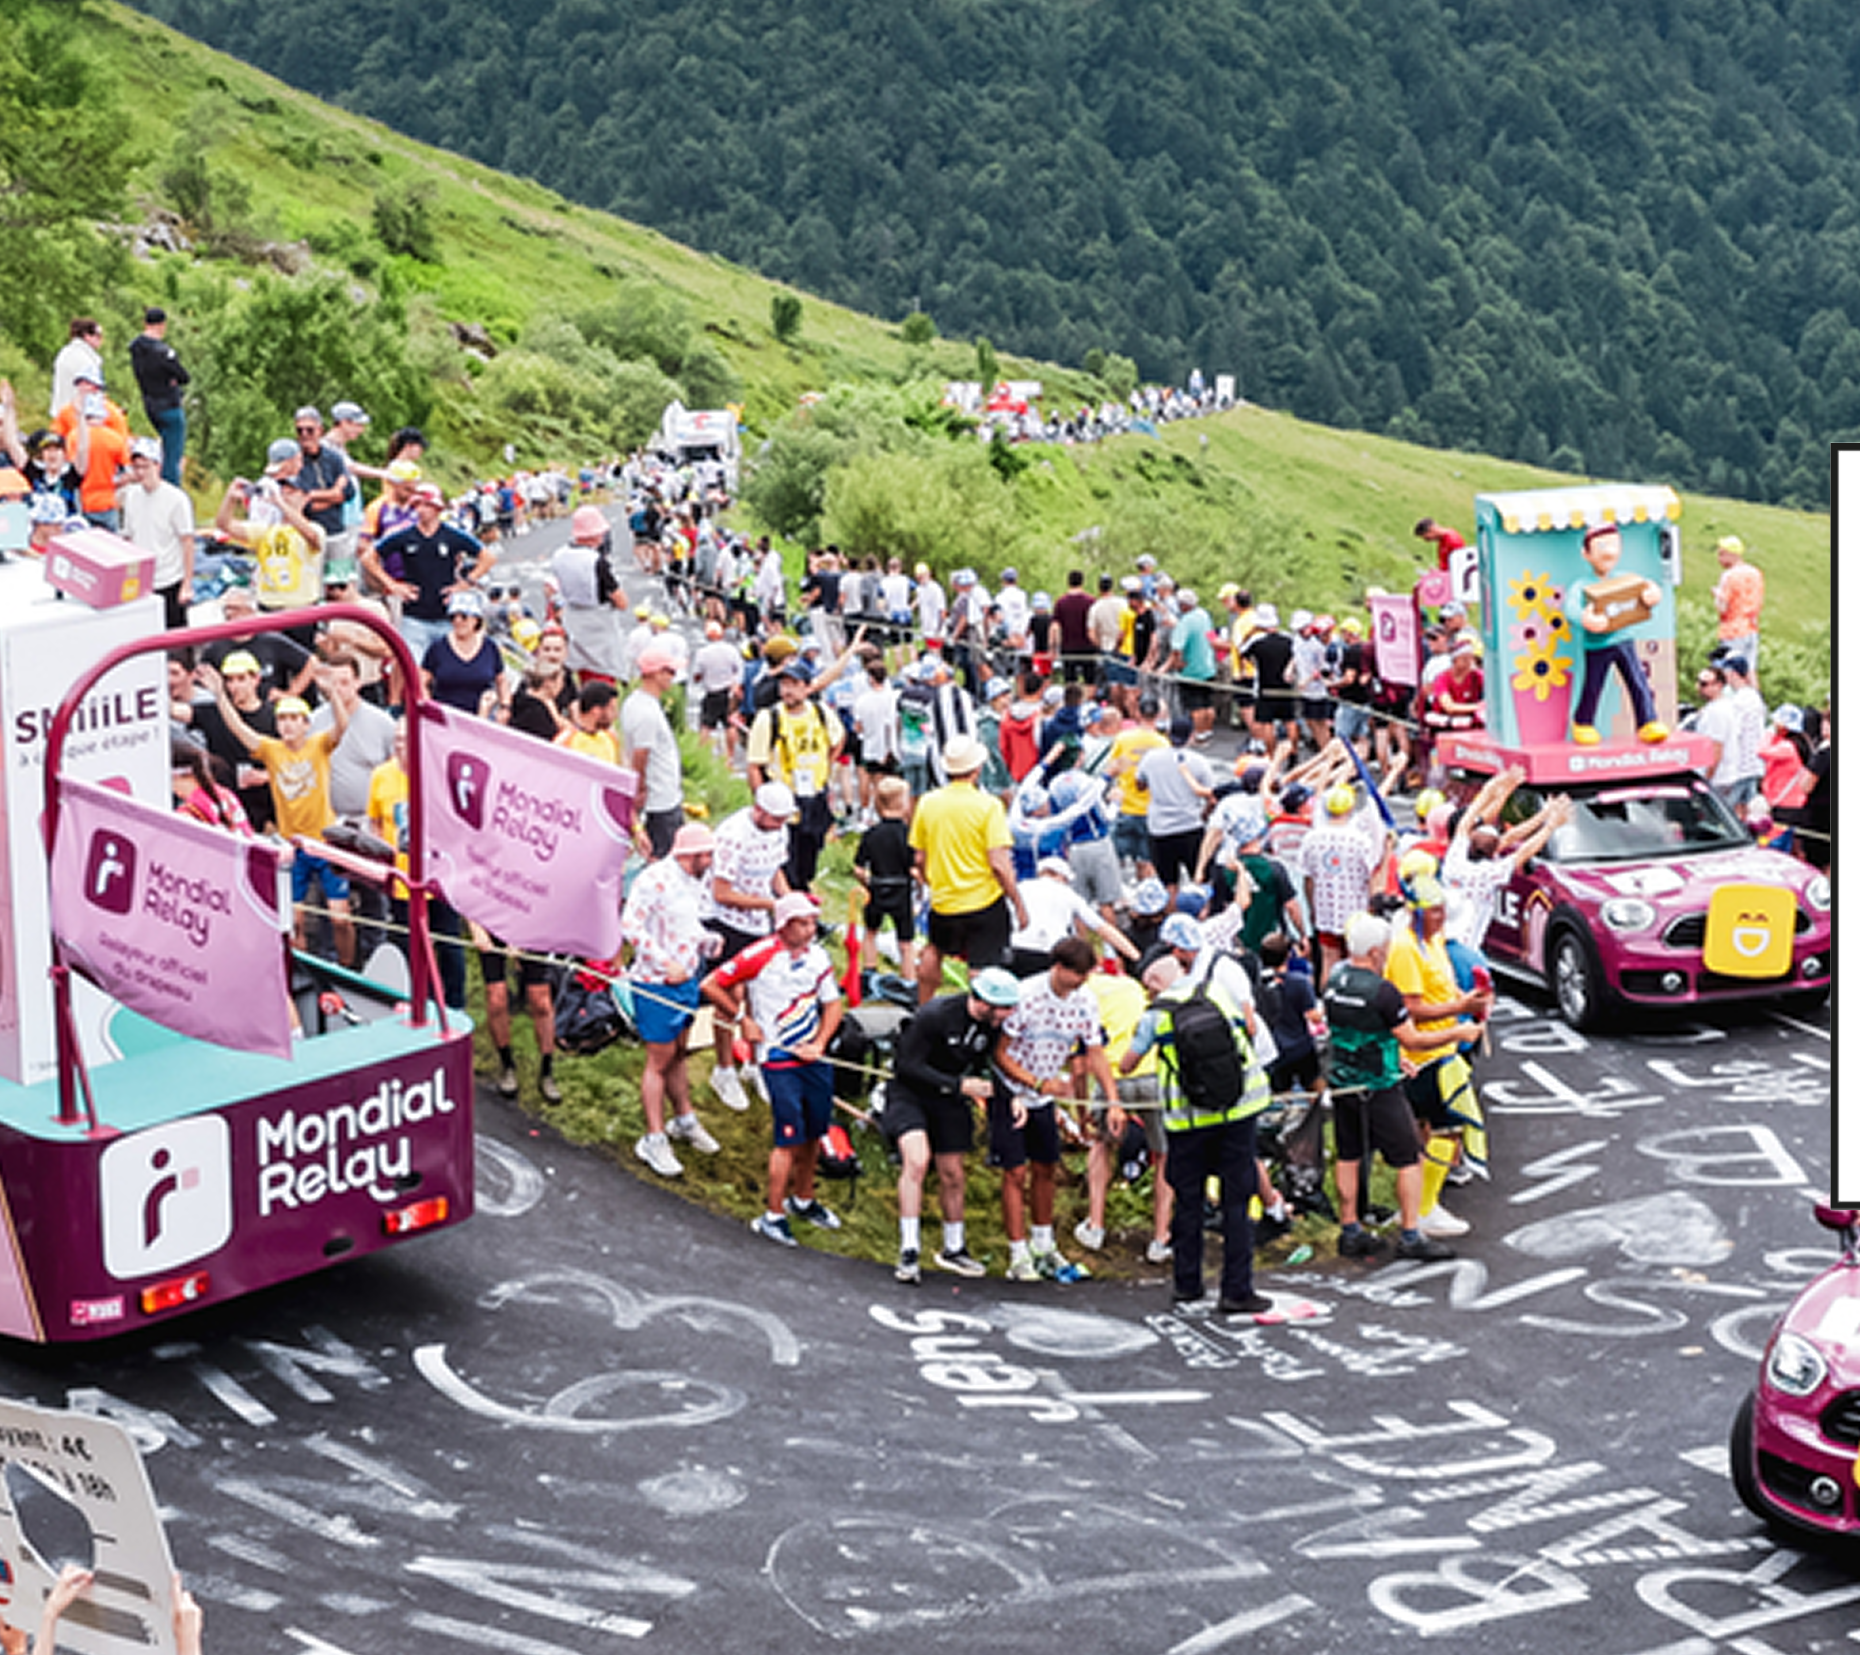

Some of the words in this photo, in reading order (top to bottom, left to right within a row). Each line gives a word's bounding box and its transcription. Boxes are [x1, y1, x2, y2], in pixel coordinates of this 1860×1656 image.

[491, 805, 559, 863] Relay
[496, 779, 582, 834] Mondial
[143, 886, 210, 949] Relay
[147, 859, 232, 916] Mondial
[257, 1067, 456, 1167] Mondial
[259, 1136, 411, 1218] Relay
